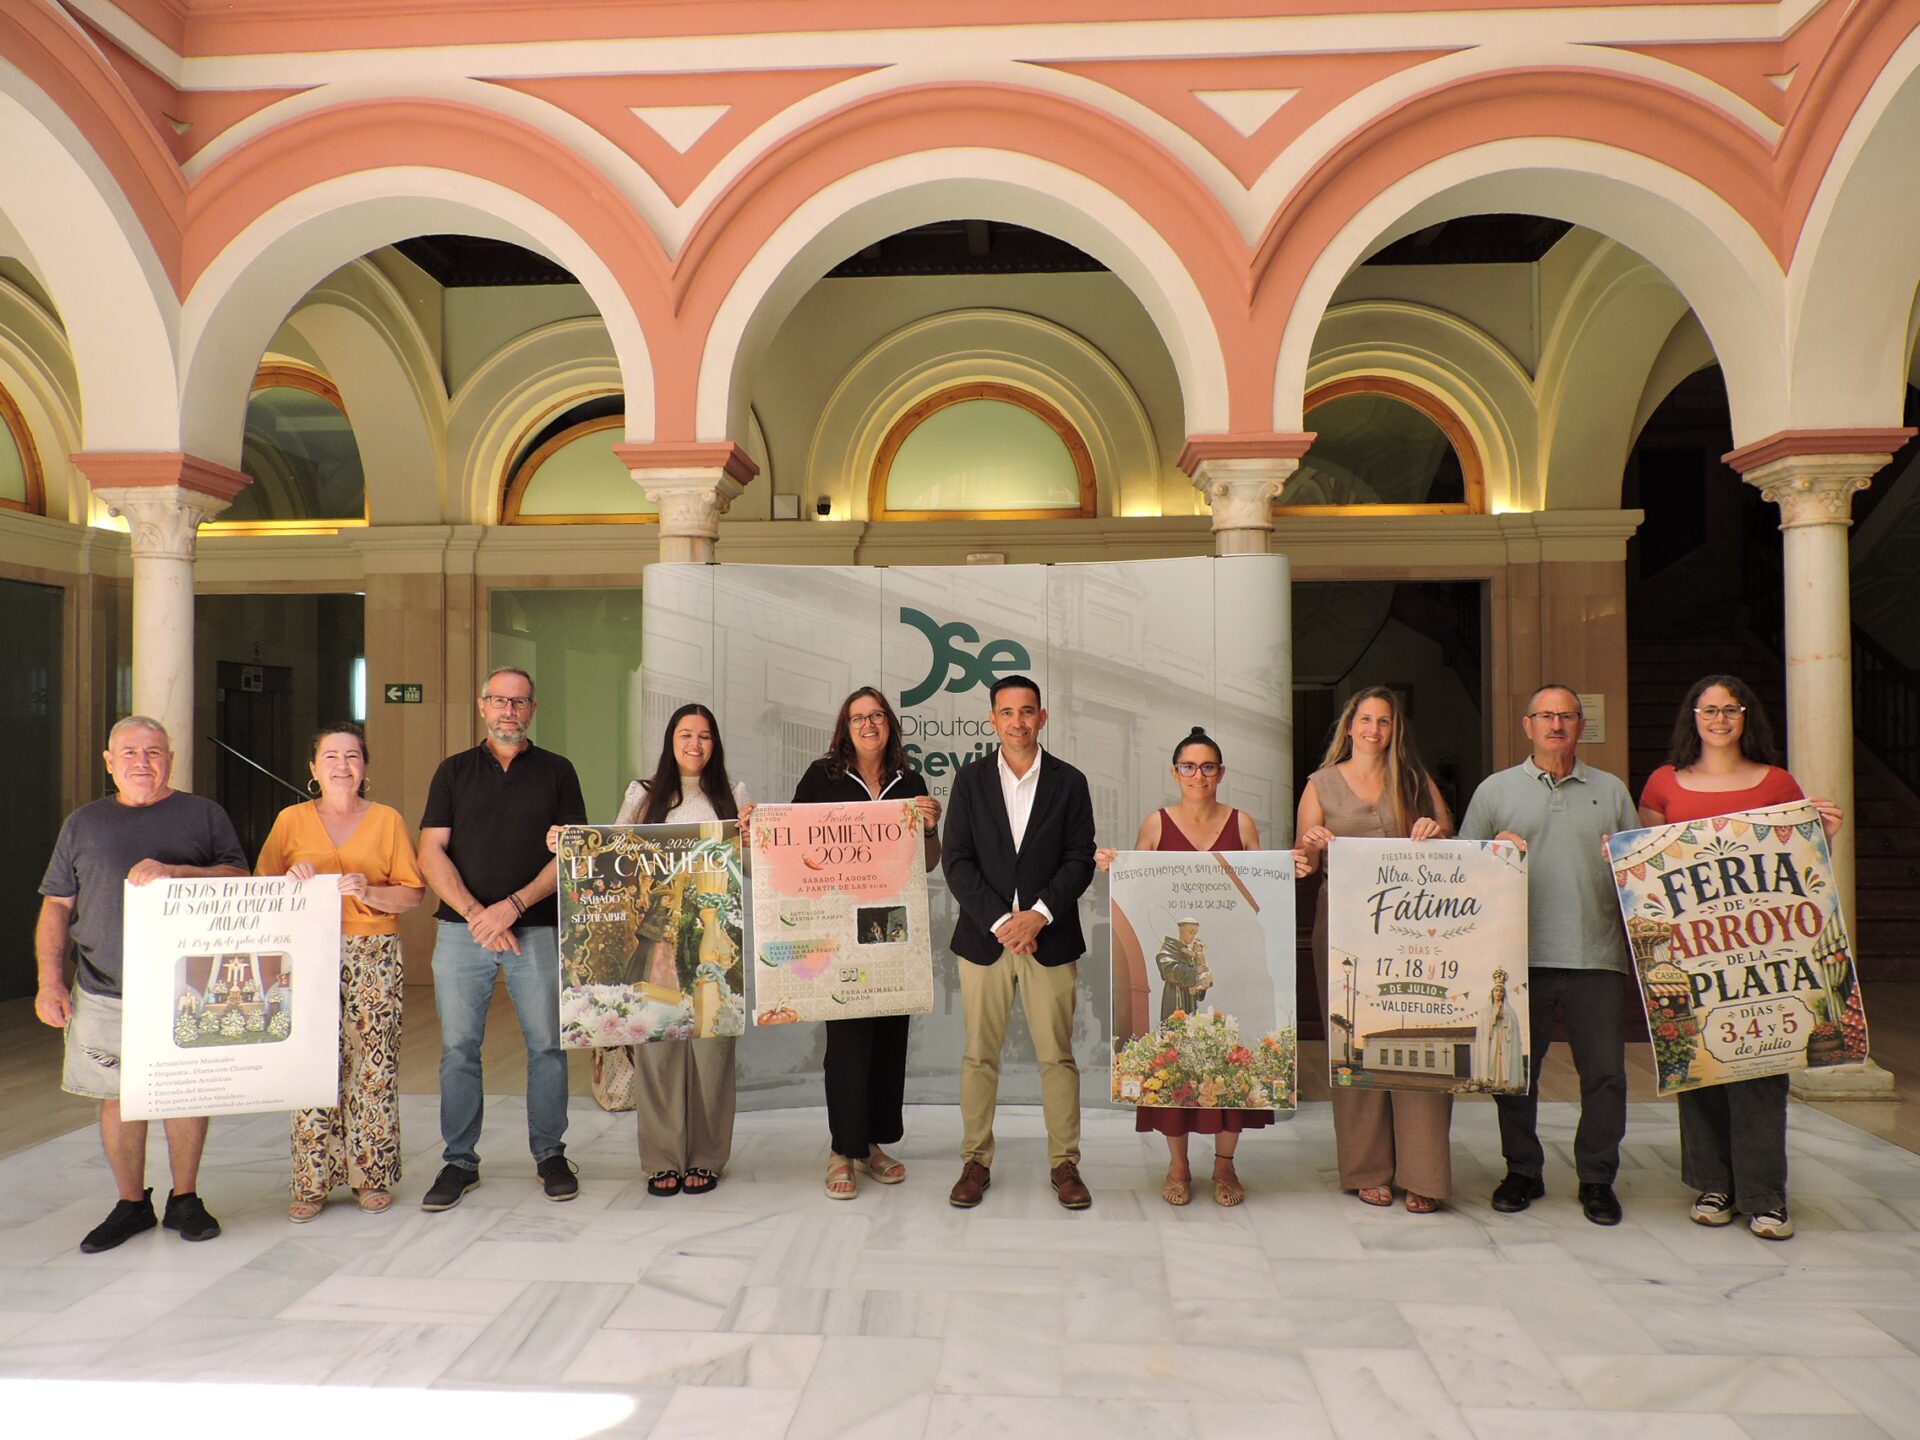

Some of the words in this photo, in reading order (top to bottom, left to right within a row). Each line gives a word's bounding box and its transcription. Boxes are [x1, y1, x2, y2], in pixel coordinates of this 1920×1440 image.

[900, 715, 996, 741] Diputac
[933, 786, 948, 796] DE
[818, 807, 852, 824] Fiesta
[854, 811, 865, 822] de
[664, 837, 698, 850] 2026
[773, 826, 800, 847] EL
[808, 823, 902, 846] PIMIENTO
[815, 844, 872, 866] 2026
[1382, 852, 1413, 861] FIESTAS
[1415, 852, 1426, 860] EN
[1428, 852, 1454, 861] HONOR
[1457, 852, 1463, 861] A
[571, 855, 604, 880] EL
[1376, 865, 1414, 885] Ntra.
[1417, 864, 1447, 886] Sra.
[1450, 866, 1467, 884] de
[845, 874, 877, 882] AGOSTO
[1657, 852, 1808, 919] FERIA
[293, 881, 303, 895] A
[806, 884, 836, 892] PARTIR
[163, 901, 180, 916] LA
[291, 897, 307, 911] LA
[1367, 886, 1483, 935] Fátima
[1724, 900, 1745, 913] DE
[1667, 900, 1824, 961] ARROYO
[1408, 946, 1431, 955] DÍAS
[1726, 953, 1748, 966] DE
[1750, 950, 1768, 962] LA
[1404, 959, 1423, 978] 18
[1427, 964, 1436, 980] y
[1440, 960, 1459, 979] 19
[1655, 972, 1683, 980] CASETA
[1389, 984, 1402, 994] DE
[1407, 984, 1438, 996] JULIO
[1687, 956, 1823, 1010] PLATA
[1381, 1000, 1455, 1015] VALDEFLORES
[1740, 1005, 1774, 1019] DÍAS
[1767, 1023, 1777, 1036] y
[1782, 1013, 1799, 1035] 5
[1734, 1042, 1754, 1056] de
[1754, 1039, 1793, 1057] julio
